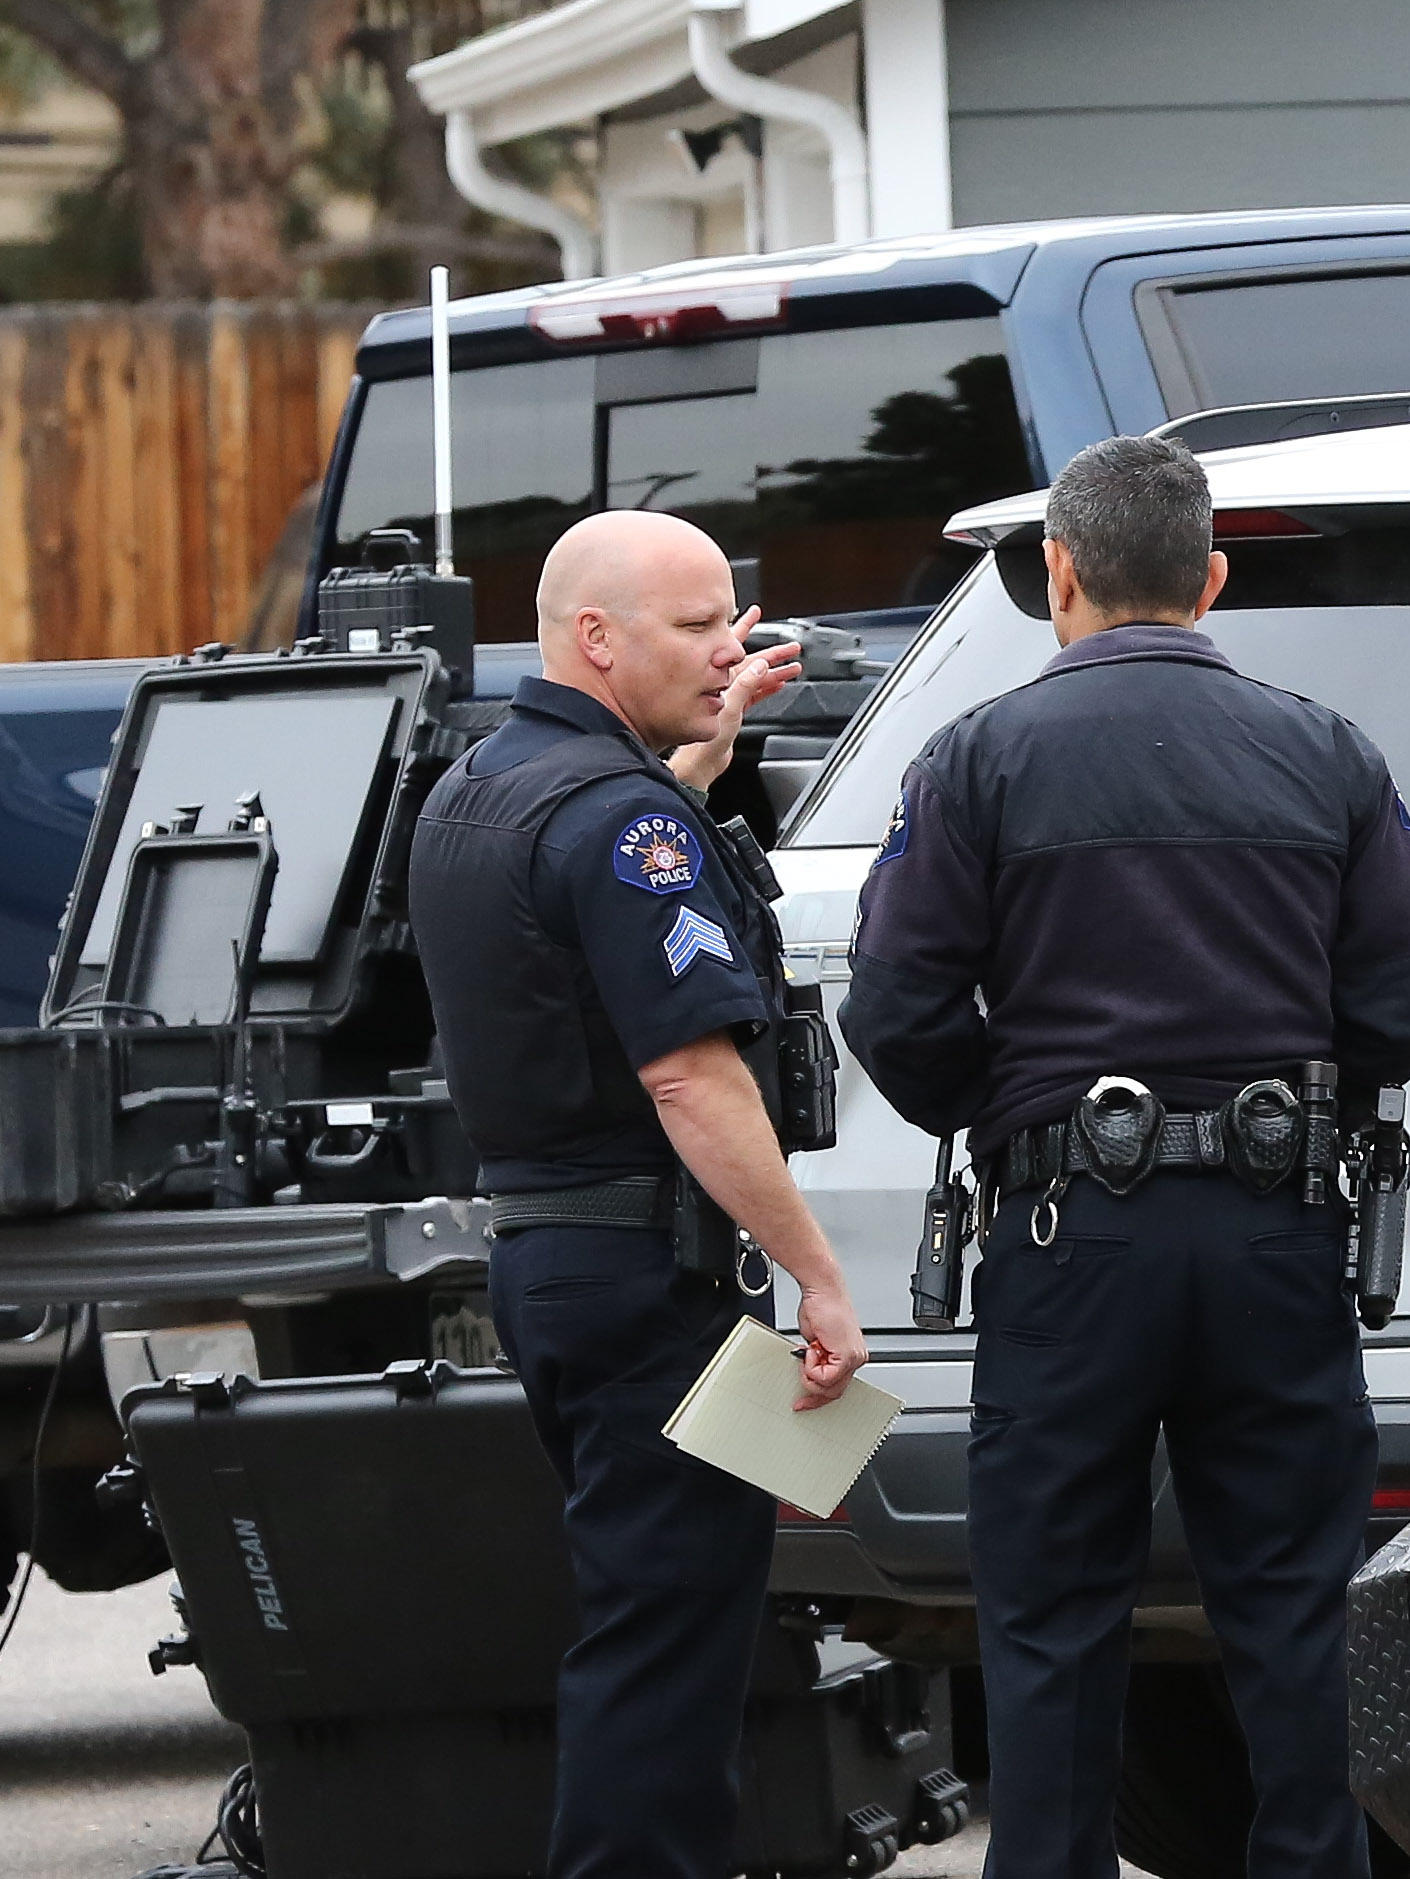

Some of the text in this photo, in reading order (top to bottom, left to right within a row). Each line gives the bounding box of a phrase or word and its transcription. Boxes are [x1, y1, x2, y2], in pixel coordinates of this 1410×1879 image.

[620, 818, 687, 857] AURORA
[649, 866, 692, 888] POLICE
[232, 1517, 288, 1631] PELICAN
